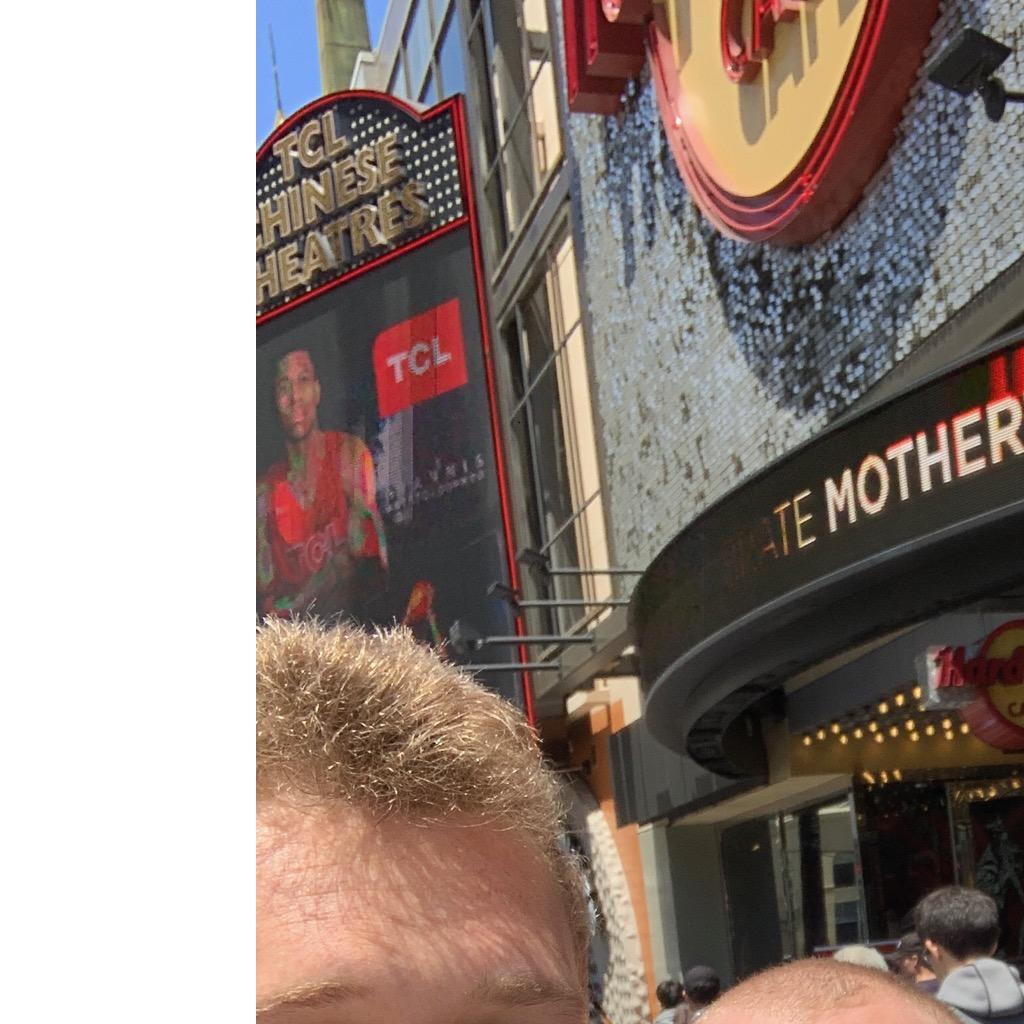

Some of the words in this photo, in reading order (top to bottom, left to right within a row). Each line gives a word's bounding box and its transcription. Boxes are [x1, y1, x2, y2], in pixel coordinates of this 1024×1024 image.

[273, 109, 348, 183] TCL
[256, 132, 404, 251] HINESE
[386, 336, 452, 384] TCL
